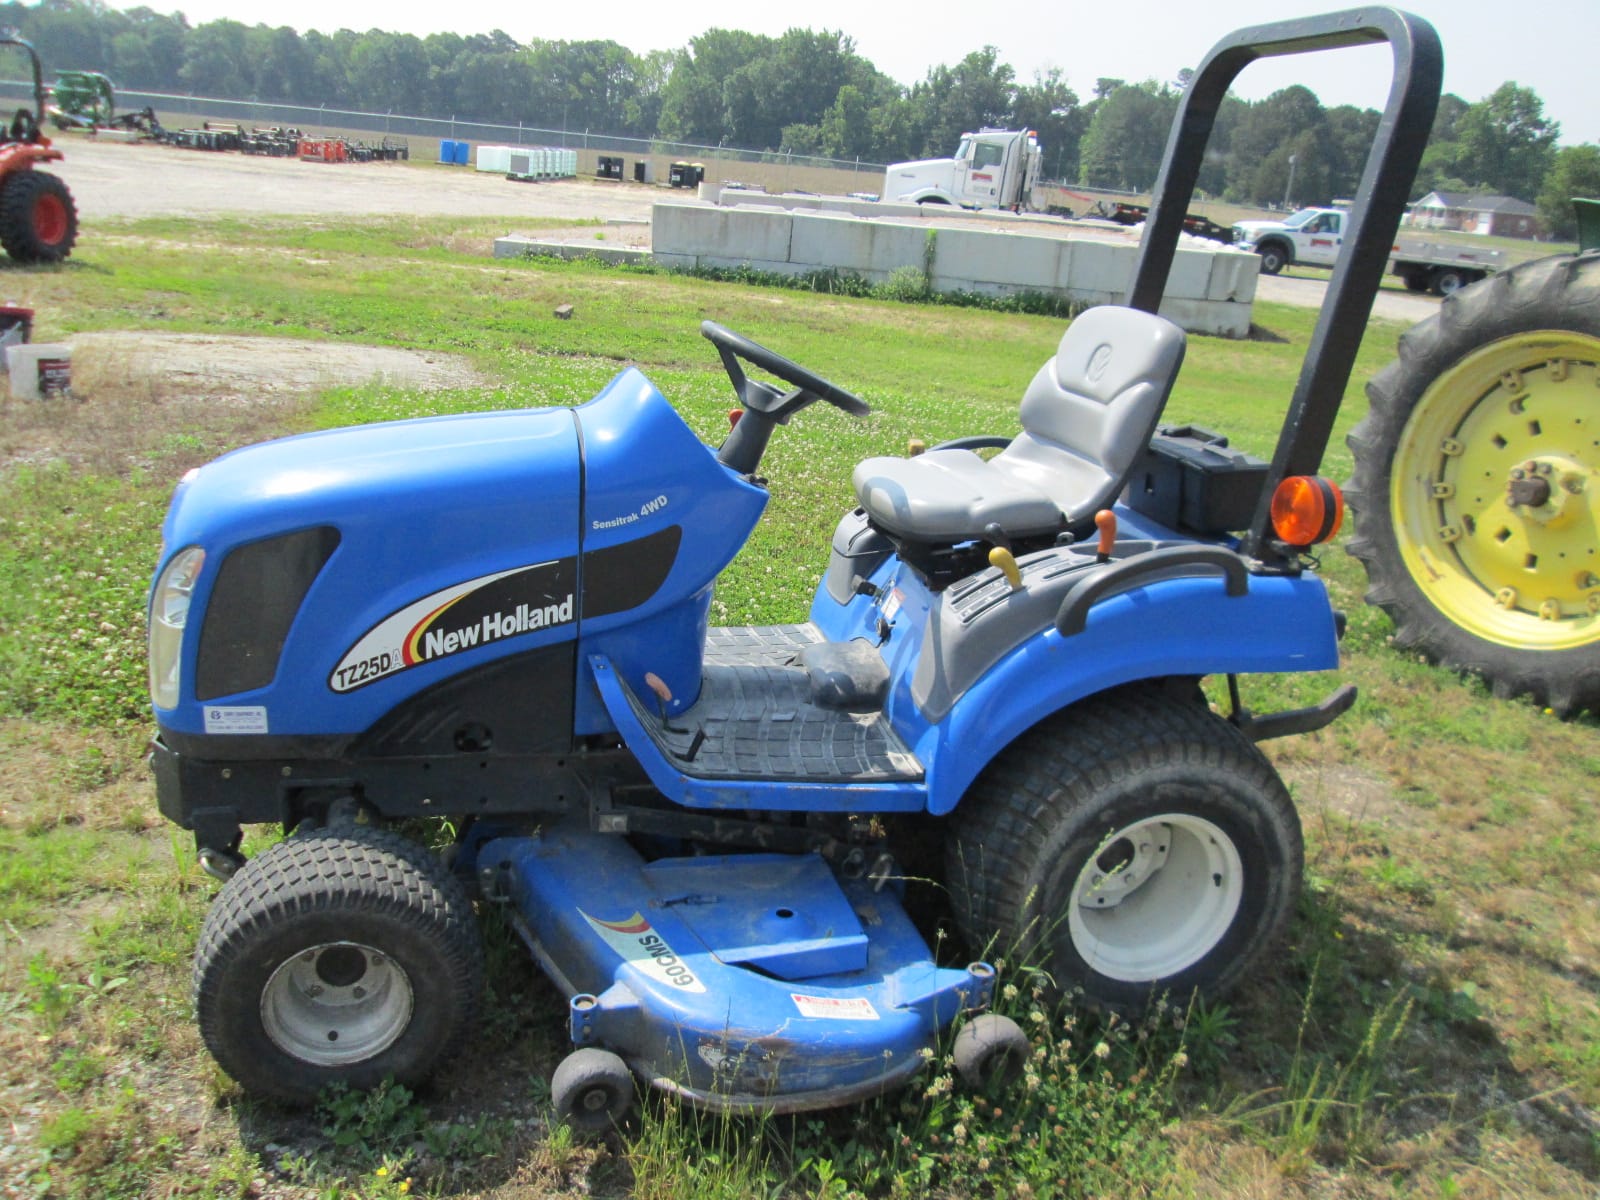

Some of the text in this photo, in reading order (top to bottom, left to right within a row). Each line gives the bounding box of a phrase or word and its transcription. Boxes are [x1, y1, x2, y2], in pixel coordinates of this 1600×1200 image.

[592, 495, 668, 530] Sensitrak 4WD
[425, 594, 573, 659] New Holland
[336, 648, 404, 688] TZ25DA
[638, 934, 694, 986] 60CMS
